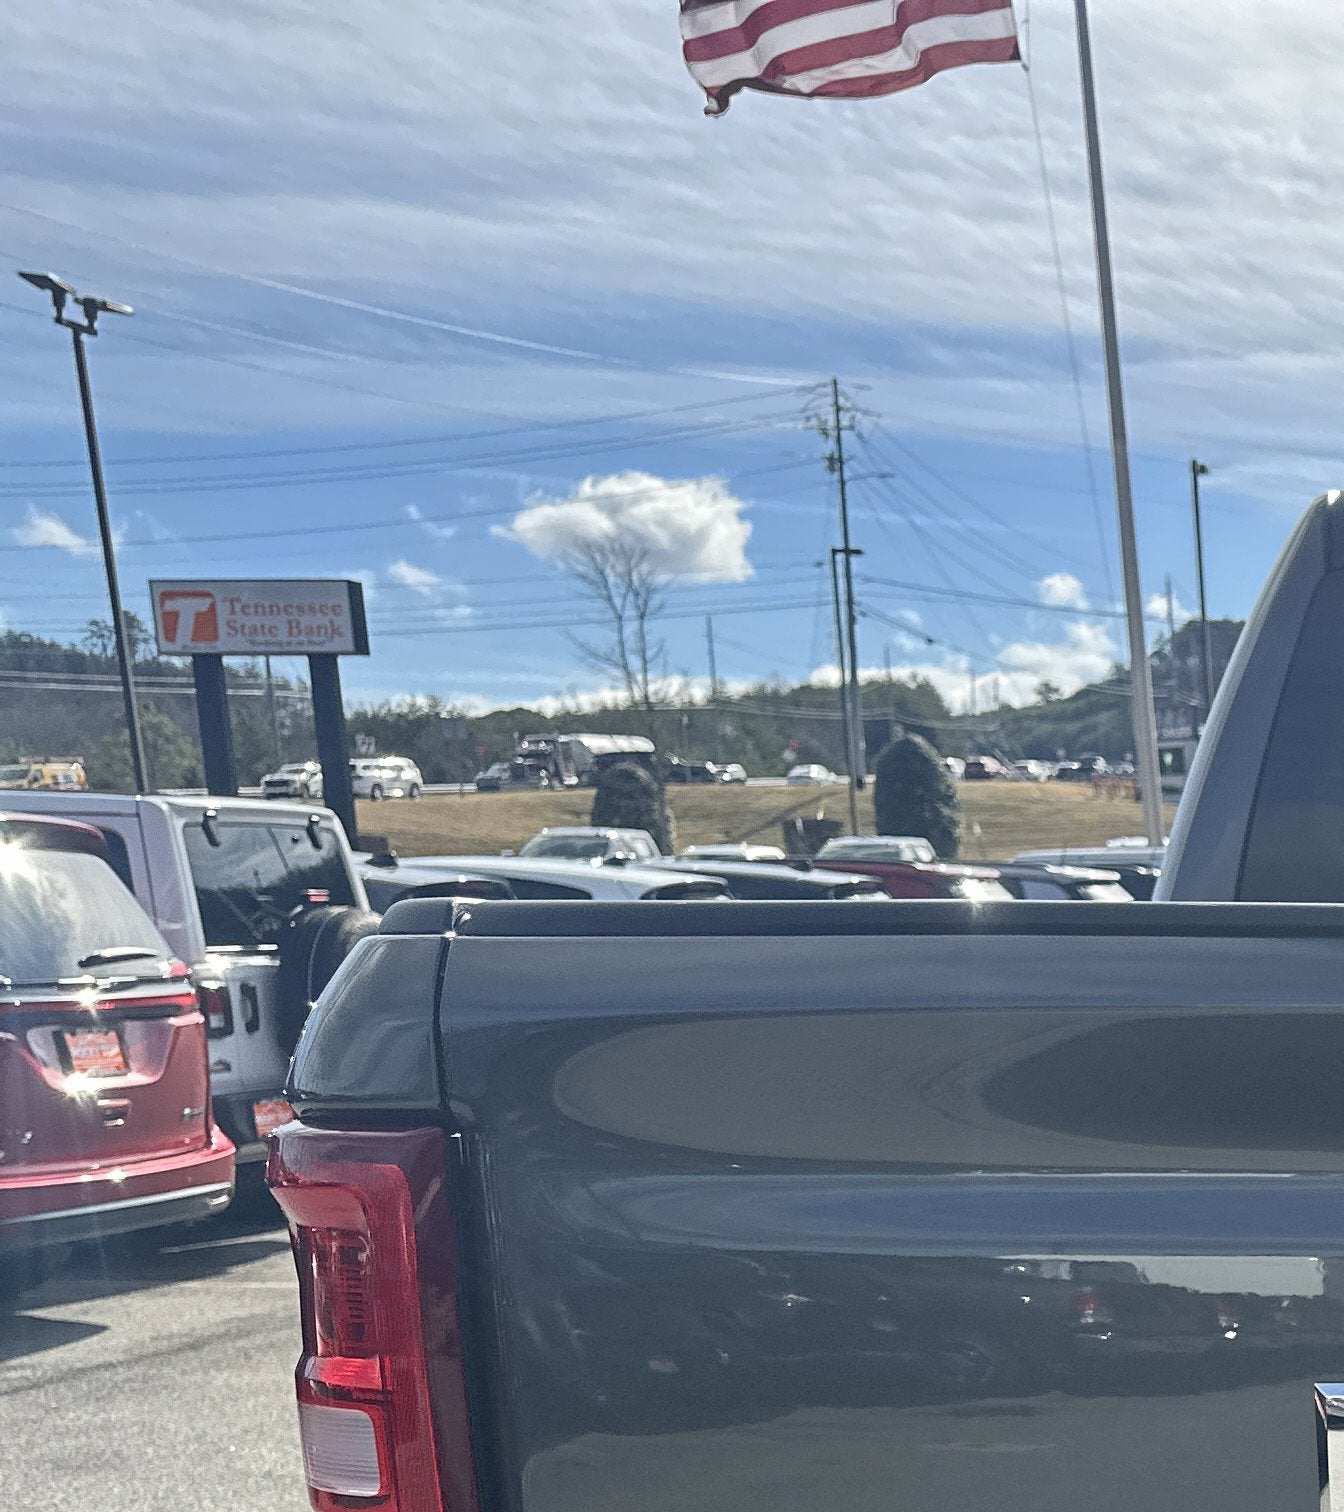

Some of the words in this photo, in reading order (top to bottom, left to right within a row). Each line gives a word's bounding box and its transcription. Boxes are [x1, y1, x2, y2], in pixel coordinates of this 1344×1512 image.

[222, 597, 343, 617] Tennessee
[225, 619, 278, 638] State
[286, 619, 343, 638] Bank
